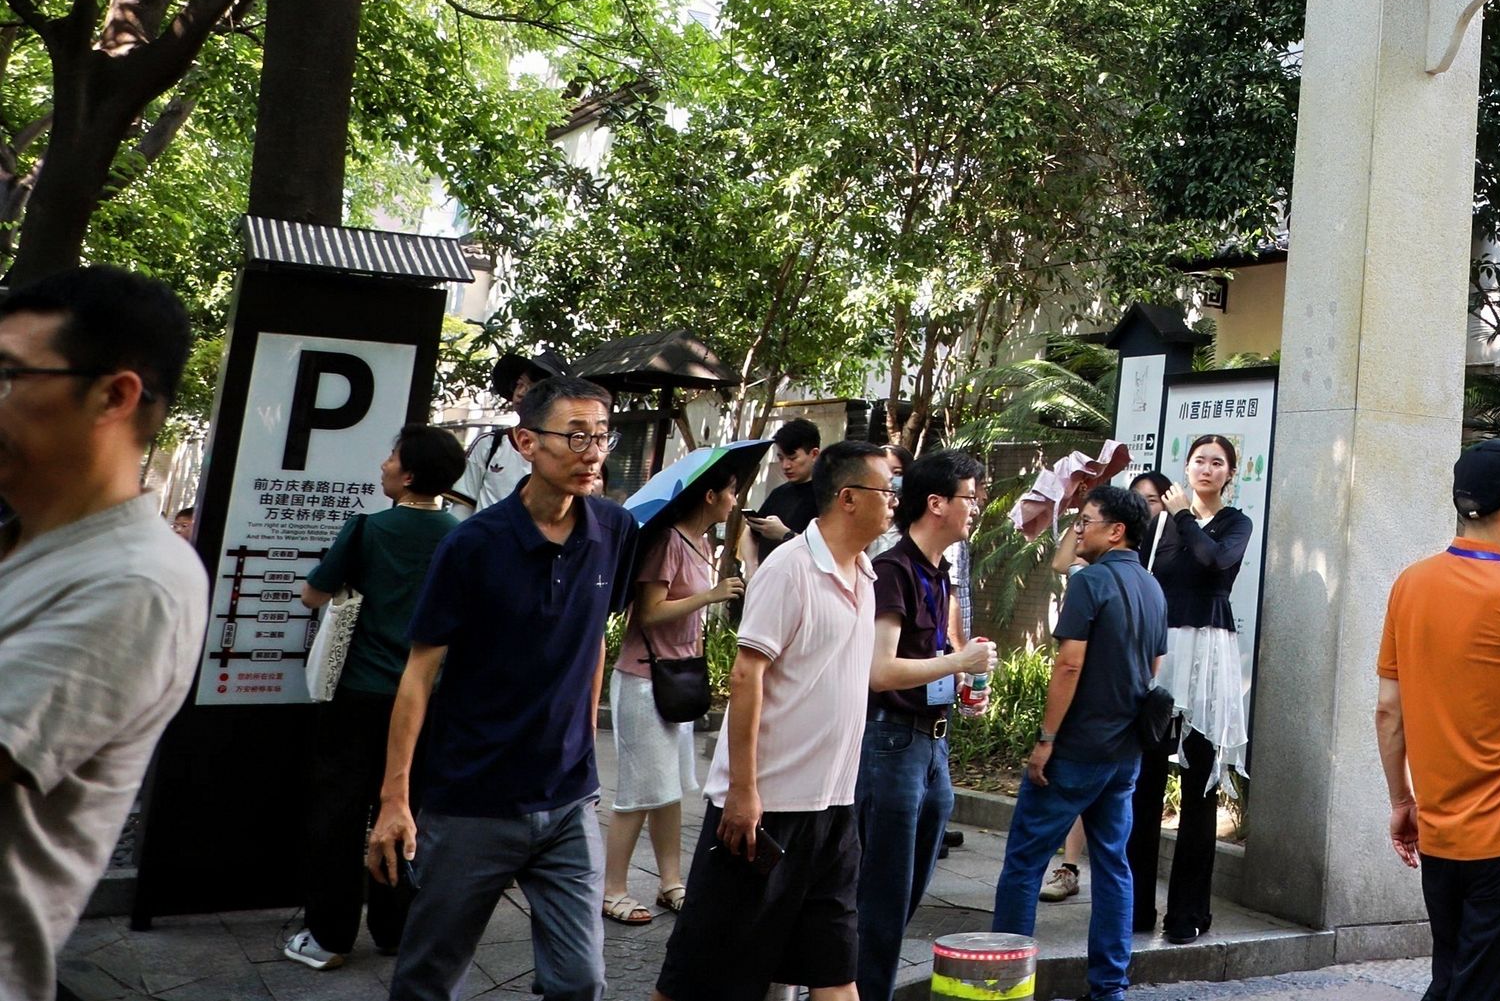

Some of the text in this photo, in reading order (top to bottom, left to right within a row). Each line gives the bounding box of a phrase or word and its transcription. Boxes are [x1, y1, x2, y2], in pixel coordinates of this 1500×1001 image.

[281, 349, 375, 471] P
[1179, 398, 1259, 420] 小营街道导览图
[254, 478, 376, 495] 前方庆春路口右转
[259, 493, 365, 508] 由建国中路进入
[264, 508, 356, 521] 万安桥停车场
